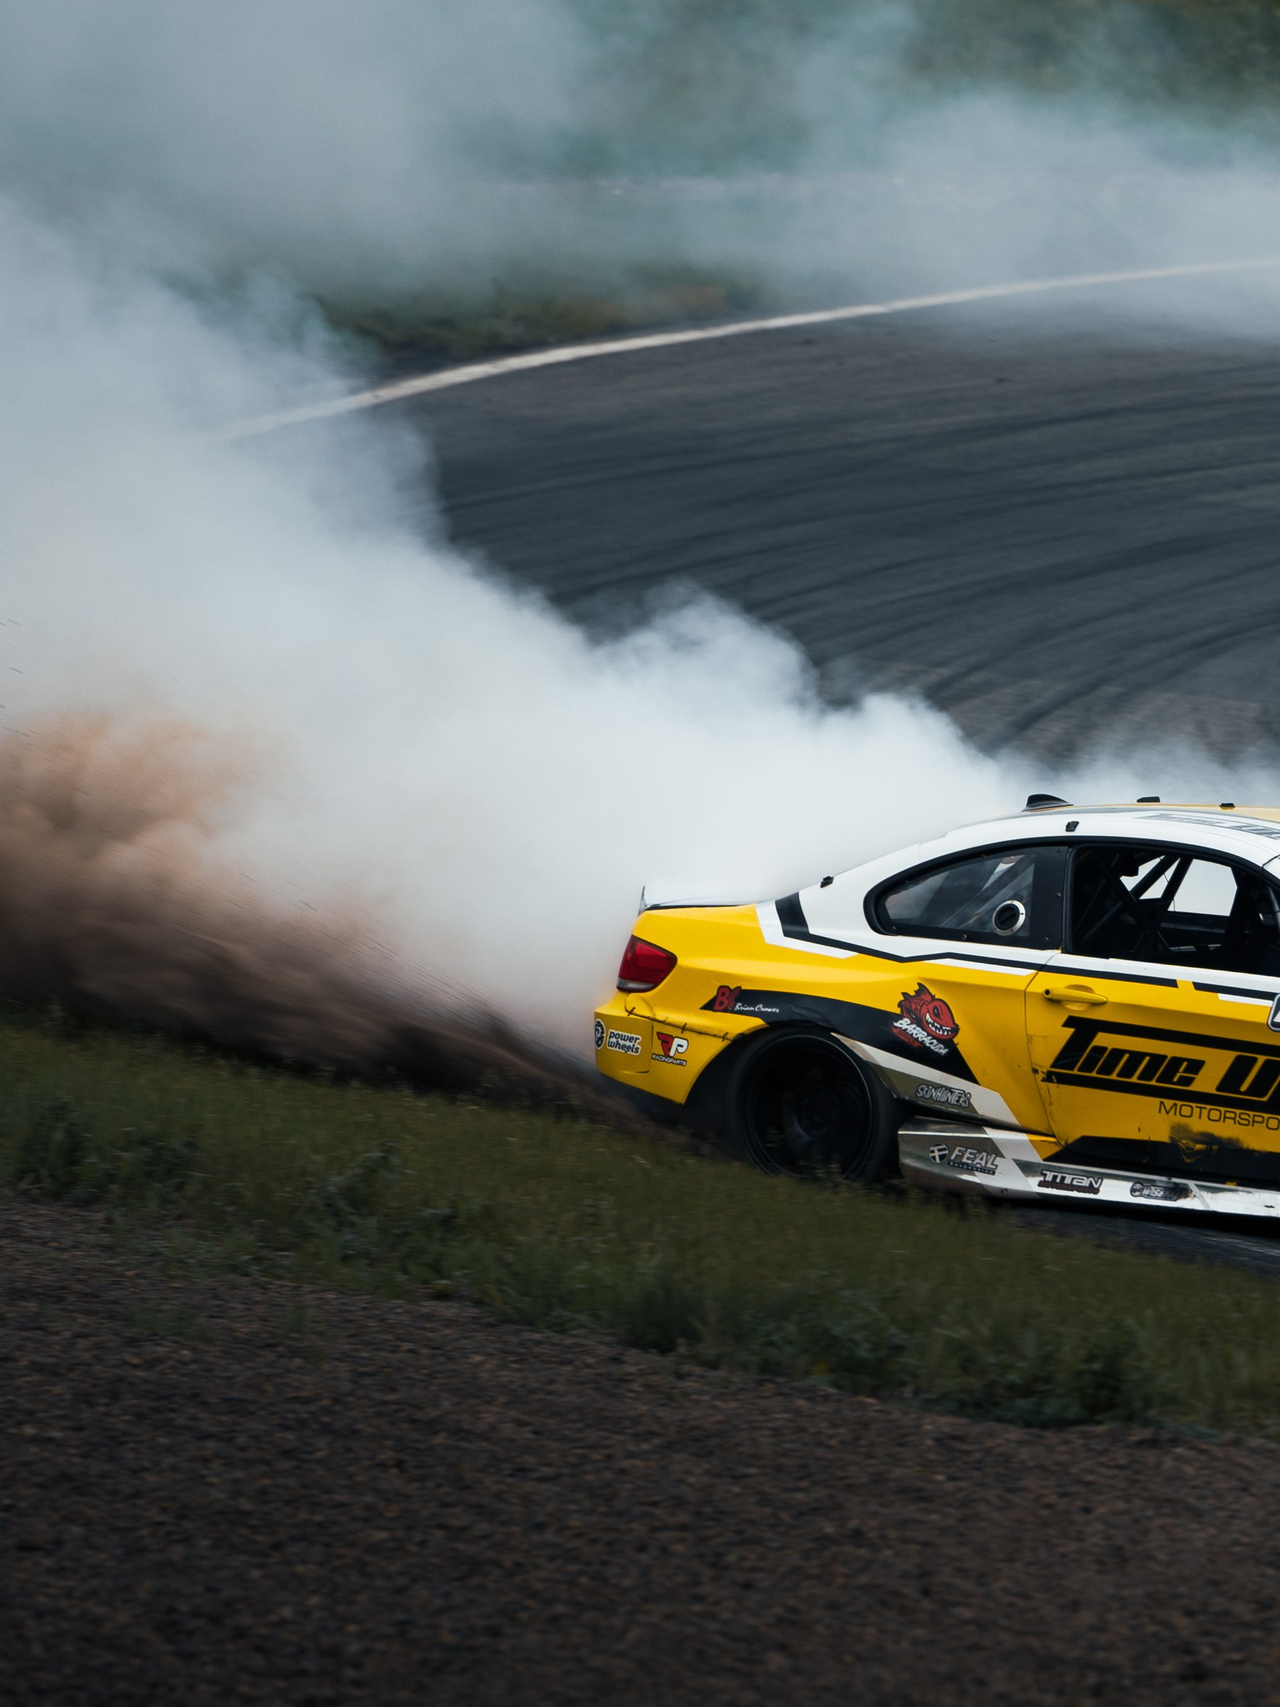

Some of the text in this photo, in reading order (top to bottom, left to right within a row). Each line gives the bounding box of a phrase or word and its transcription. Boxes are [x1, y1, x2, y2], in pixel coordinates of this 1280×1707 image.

[607, 1039, 640, 1054] wheels
[609, 1030, 640, 1045] power
[893, 1017, 949, 1055] BARRACUDA
[1050, 1015, 1206, 1087] Time
[950, 1146, 998, 1169] FEAL
